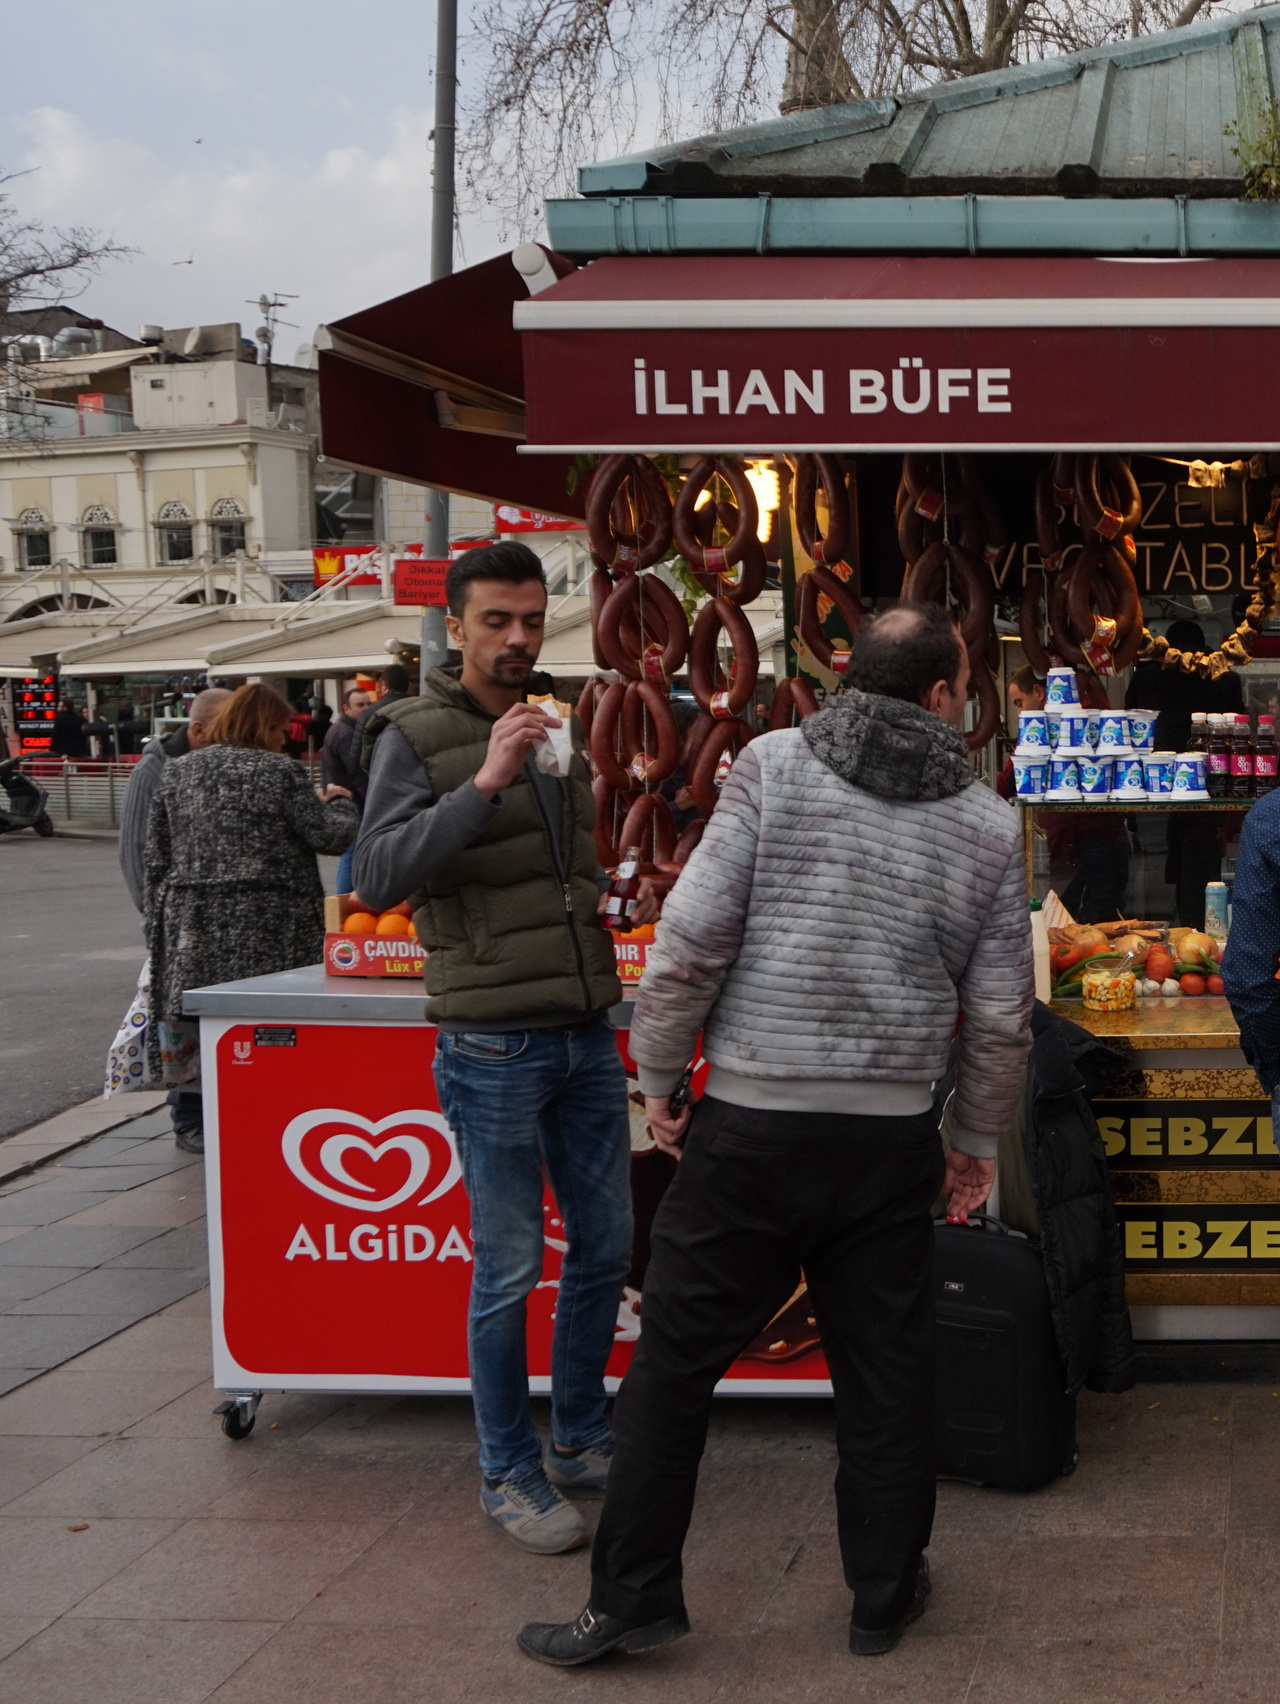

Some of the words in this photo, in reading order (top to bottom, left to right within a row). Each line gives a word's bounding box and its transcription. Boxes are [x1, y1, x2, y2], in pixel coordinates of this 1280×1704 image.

[633, 356, 825, 416] İLHAN
[848, 356, 1012, 415] BÜFE
[409, 565, 446, 575] Dikkat
[398, 589, 440, 600] Bariyer
[385, 959, 409, 973] Lüx
[1097, 1116, 1280, 1157] SEBZE
